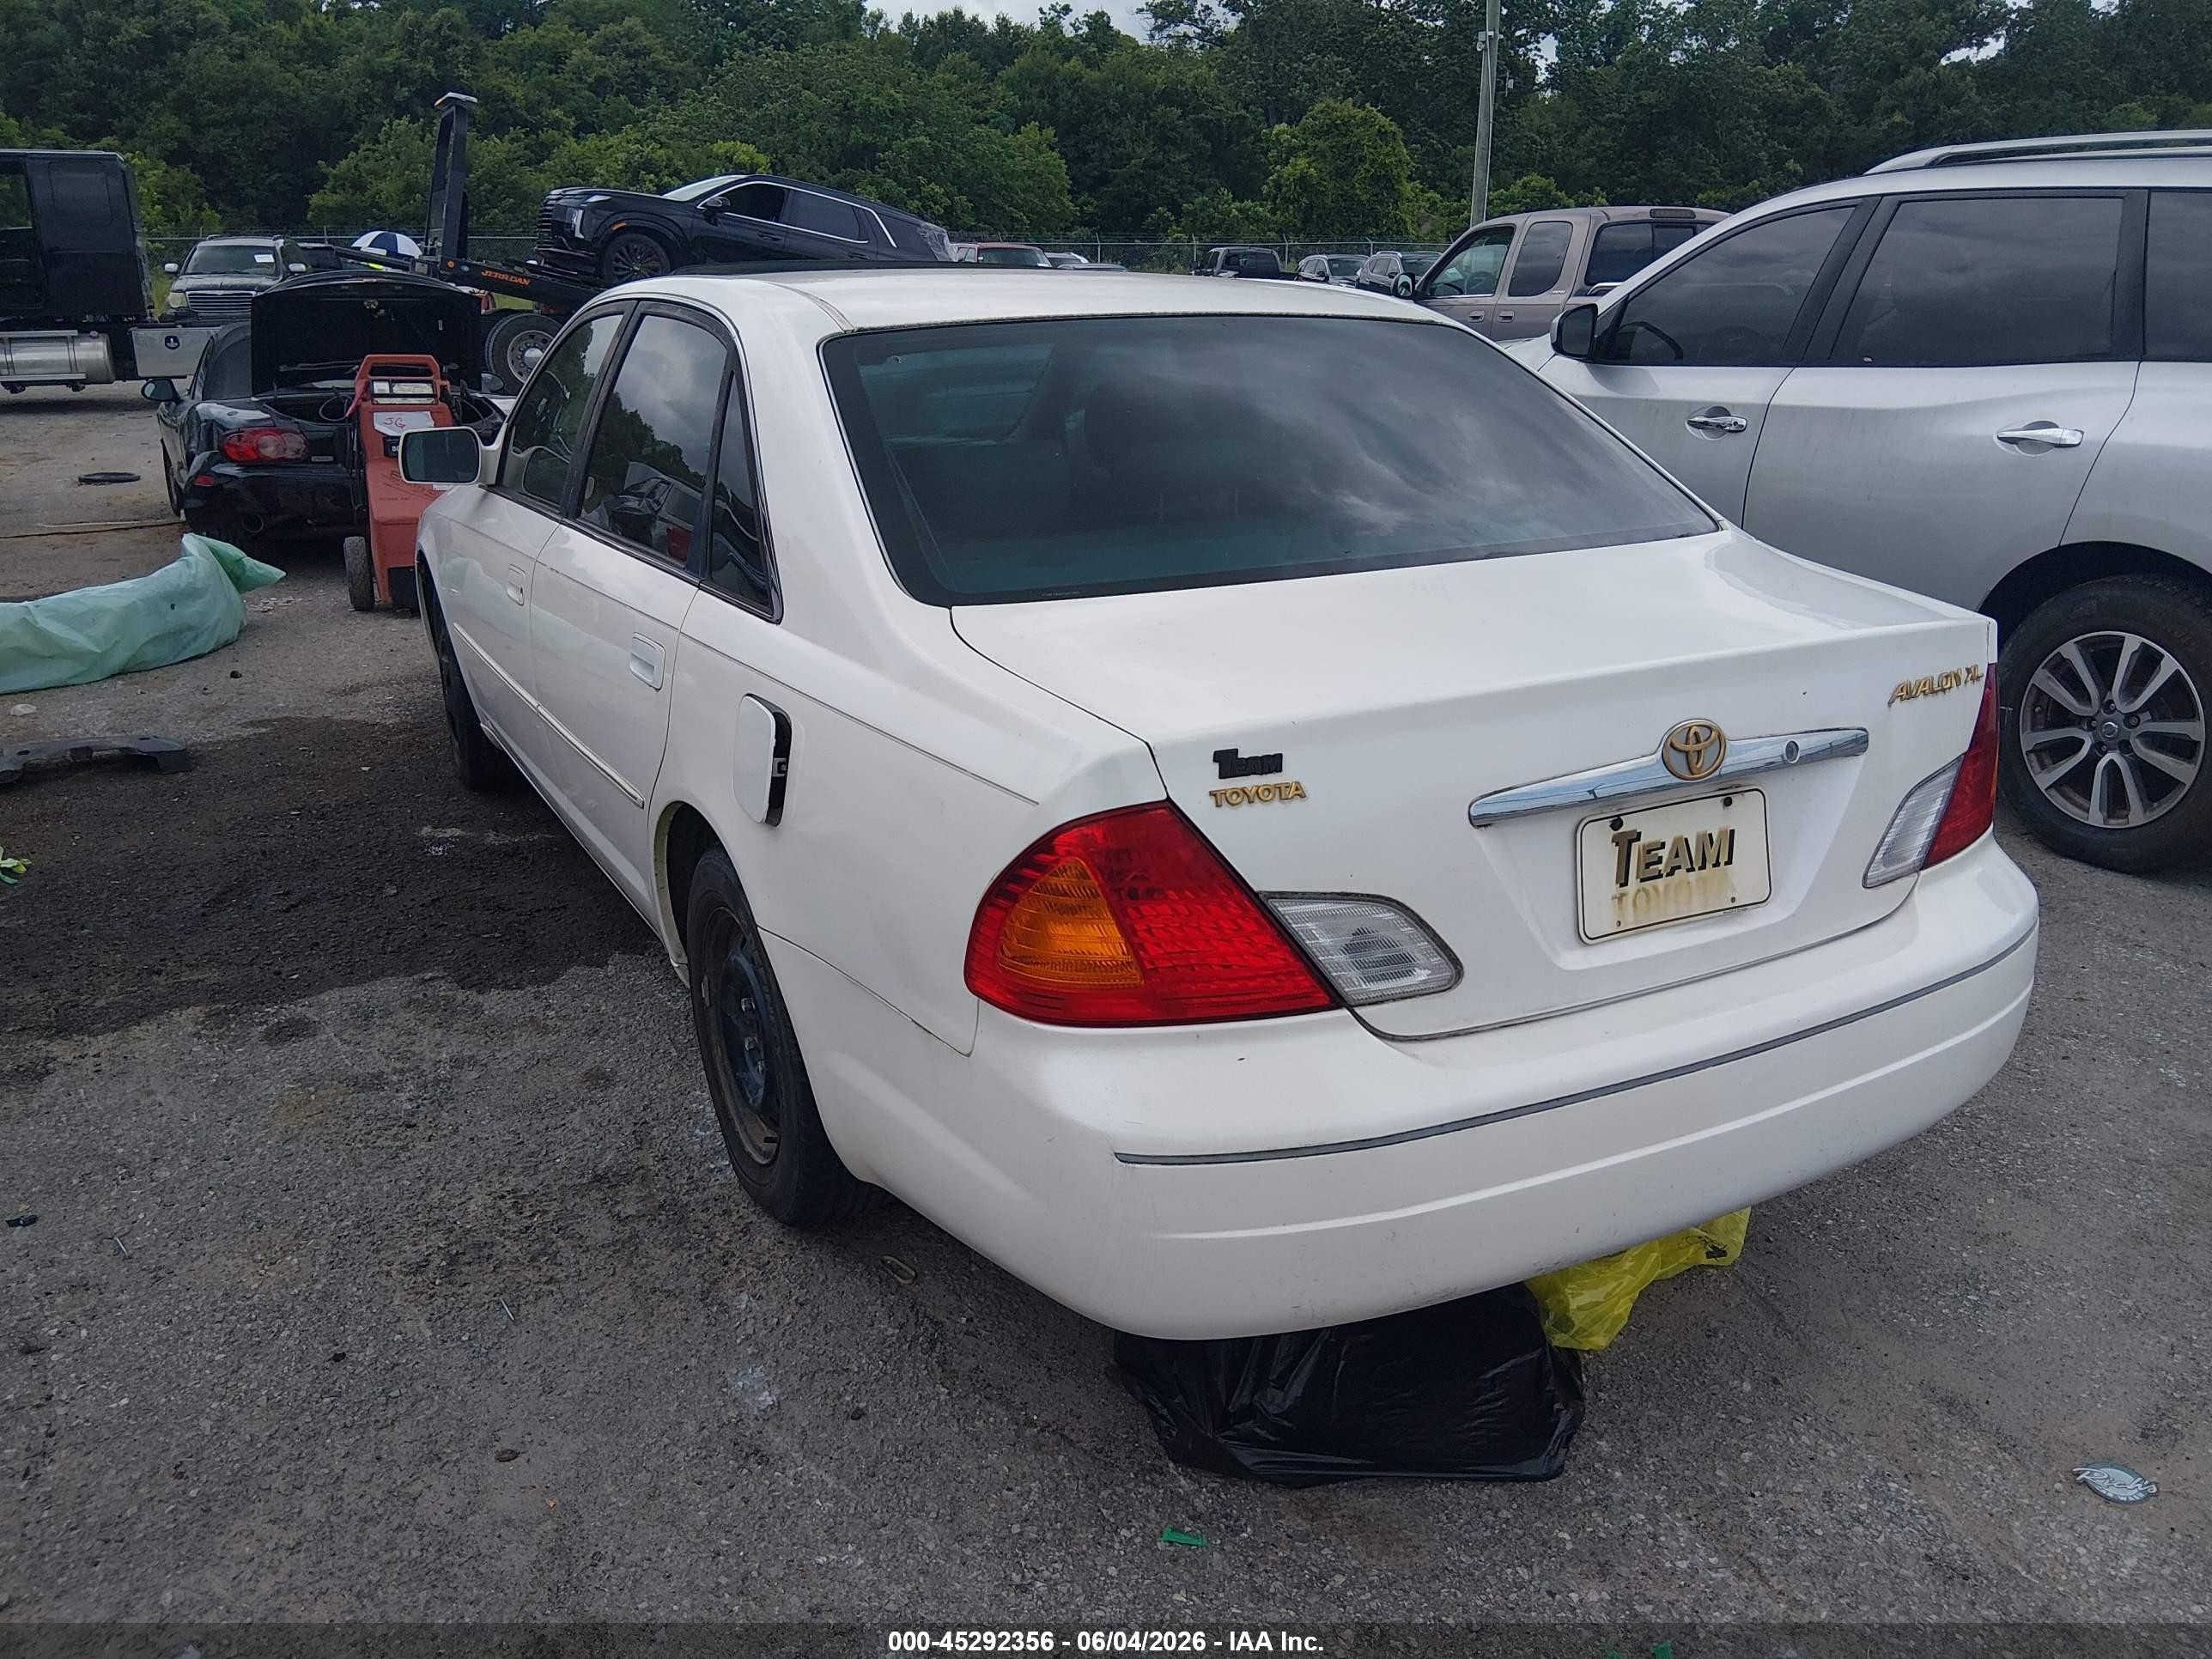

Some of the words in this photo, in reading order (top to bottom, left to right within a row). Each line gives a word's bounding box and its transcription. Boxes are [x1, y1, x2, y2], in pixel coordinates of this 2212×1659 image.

[1887, 669, 1962, 707] AVALON
[1212, 748, 1283, 779] TEAM
[1209, 781, 1306, 807] TOYOTA
[1611, 826, 1735, 888] TEAM
[1611, 874, 1729, 912] TOYO
